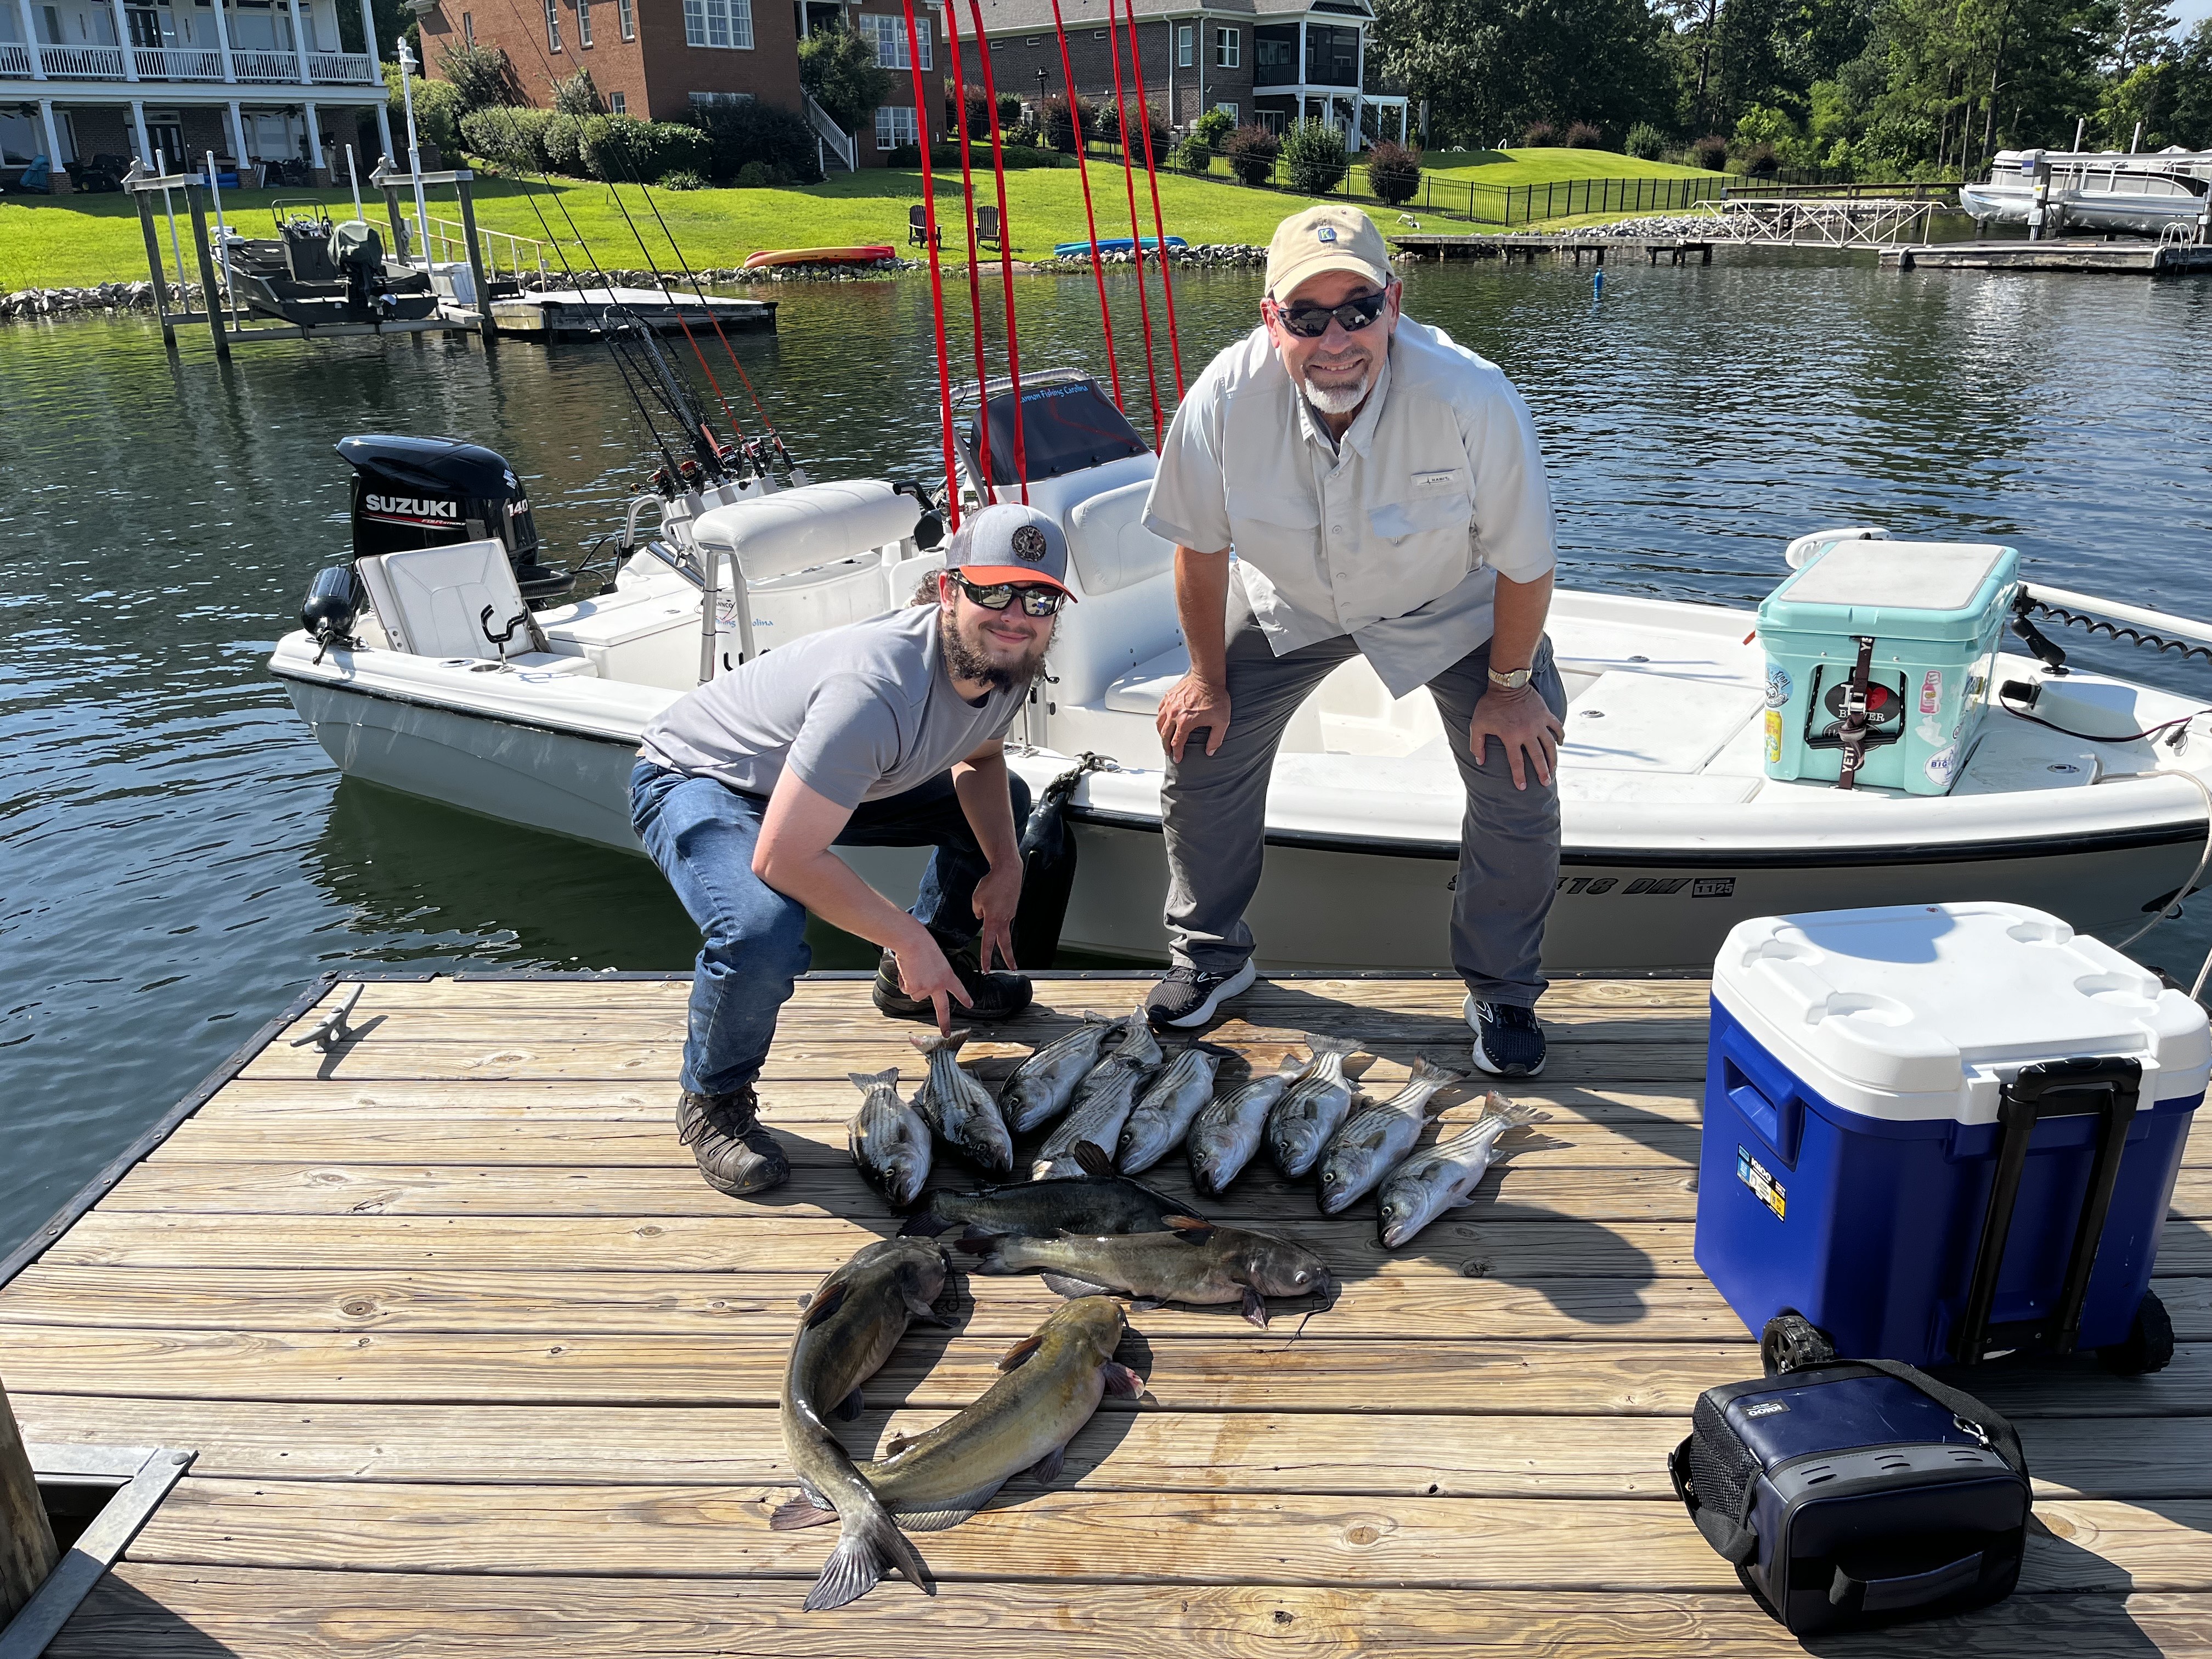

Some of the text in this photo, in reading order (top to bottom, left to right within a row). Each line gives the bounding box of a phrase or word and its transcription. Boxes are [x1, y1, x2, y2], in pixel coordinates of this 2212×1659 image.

[1040, 388, 1064, 397] Fishing
[1064, 383, 1088, 394] Carolina
[366, 494, 456, 517] SUZUKI
[507, 499, 528, 517] 140
[752, 618, 774, 627] olina
[1838, 709, 1885, 722] BVER
[1842, 746, 1855, 773] YETI
[1556, 877, 1694, 895] 18 DM
[1715, 884, 1734, 893] 25
[1751, 1156, 1771, 1182] IGLOO
[1748, 1404, 1782, 1416] IGLOO
